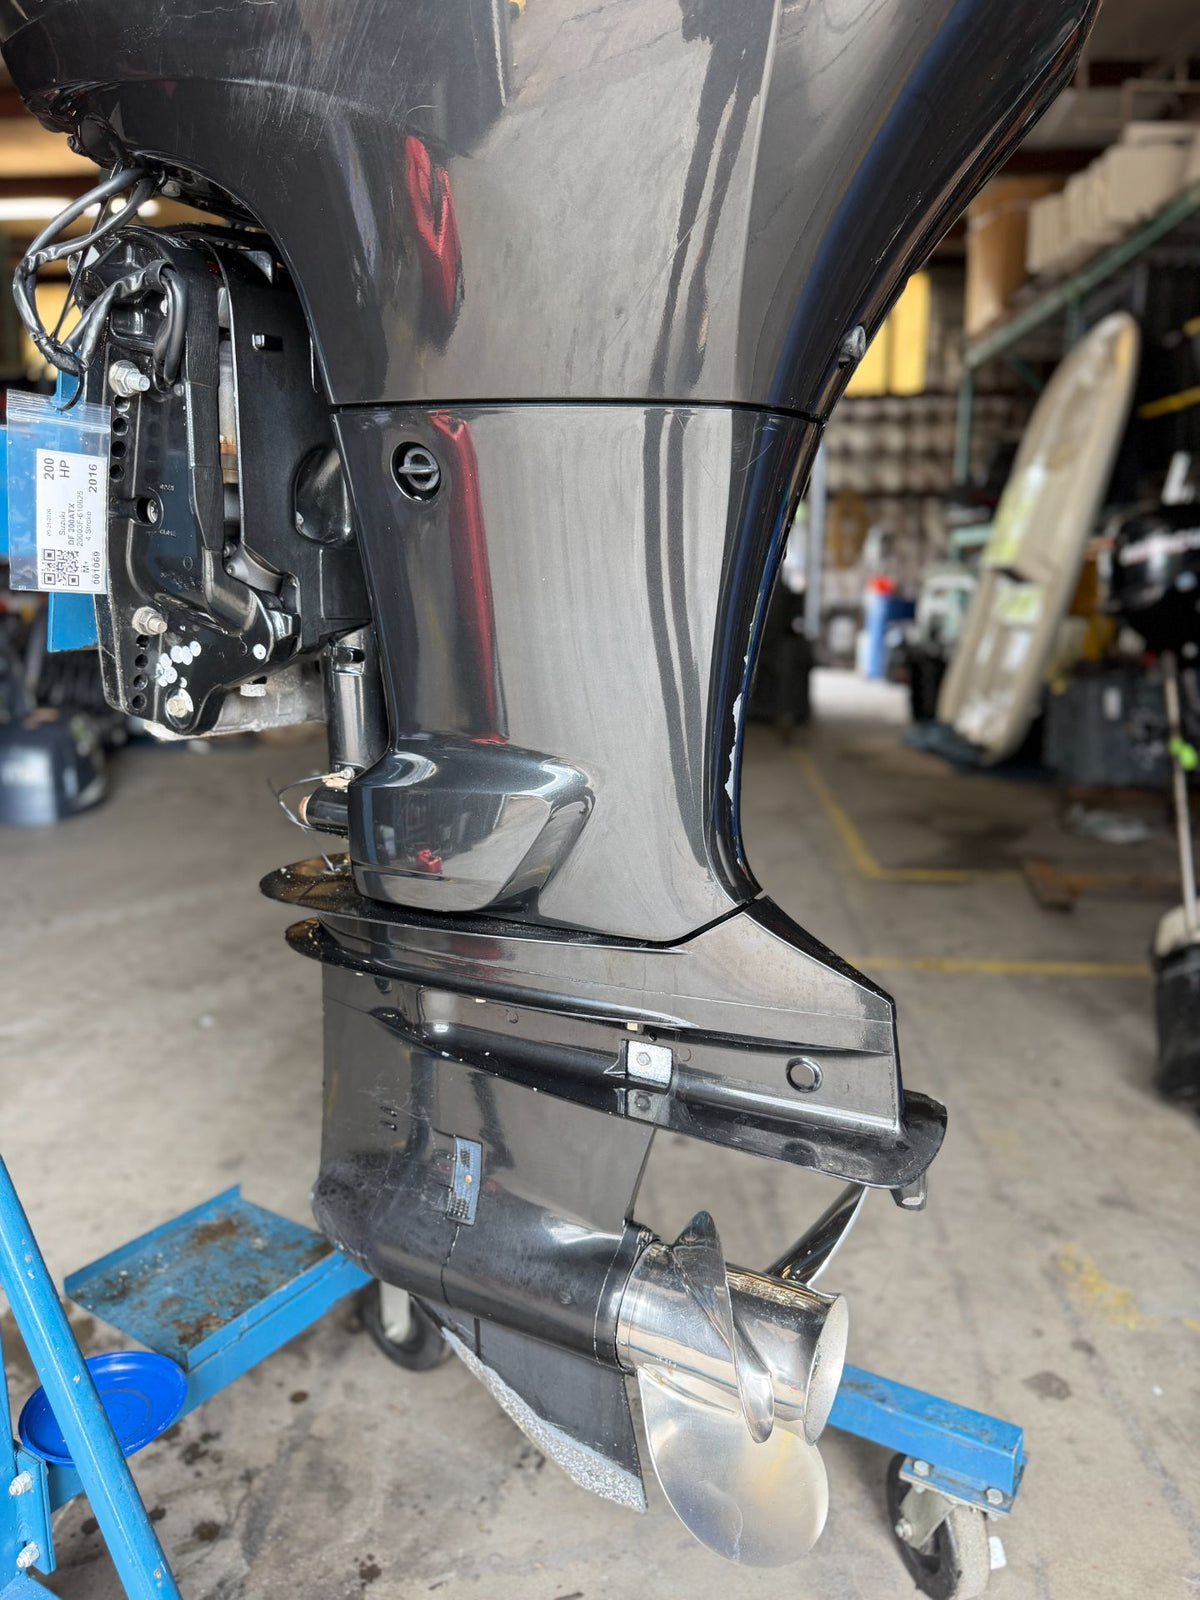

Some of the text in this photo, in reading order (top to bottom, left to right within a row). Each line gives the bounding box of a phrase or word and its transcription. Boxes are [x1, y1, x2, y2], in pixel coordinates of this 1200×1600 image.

[43, 457, 55, 480] 200
[59, 460, 70, 479] HP
[88, 464, 98, 493] 2016
[58, 511, 66, 536] Suzuki
[67, 503, 75, 546] DF 200ATX
[84, 511, 92, 535] Stroke
[93, 551, 101, 585] 001069
